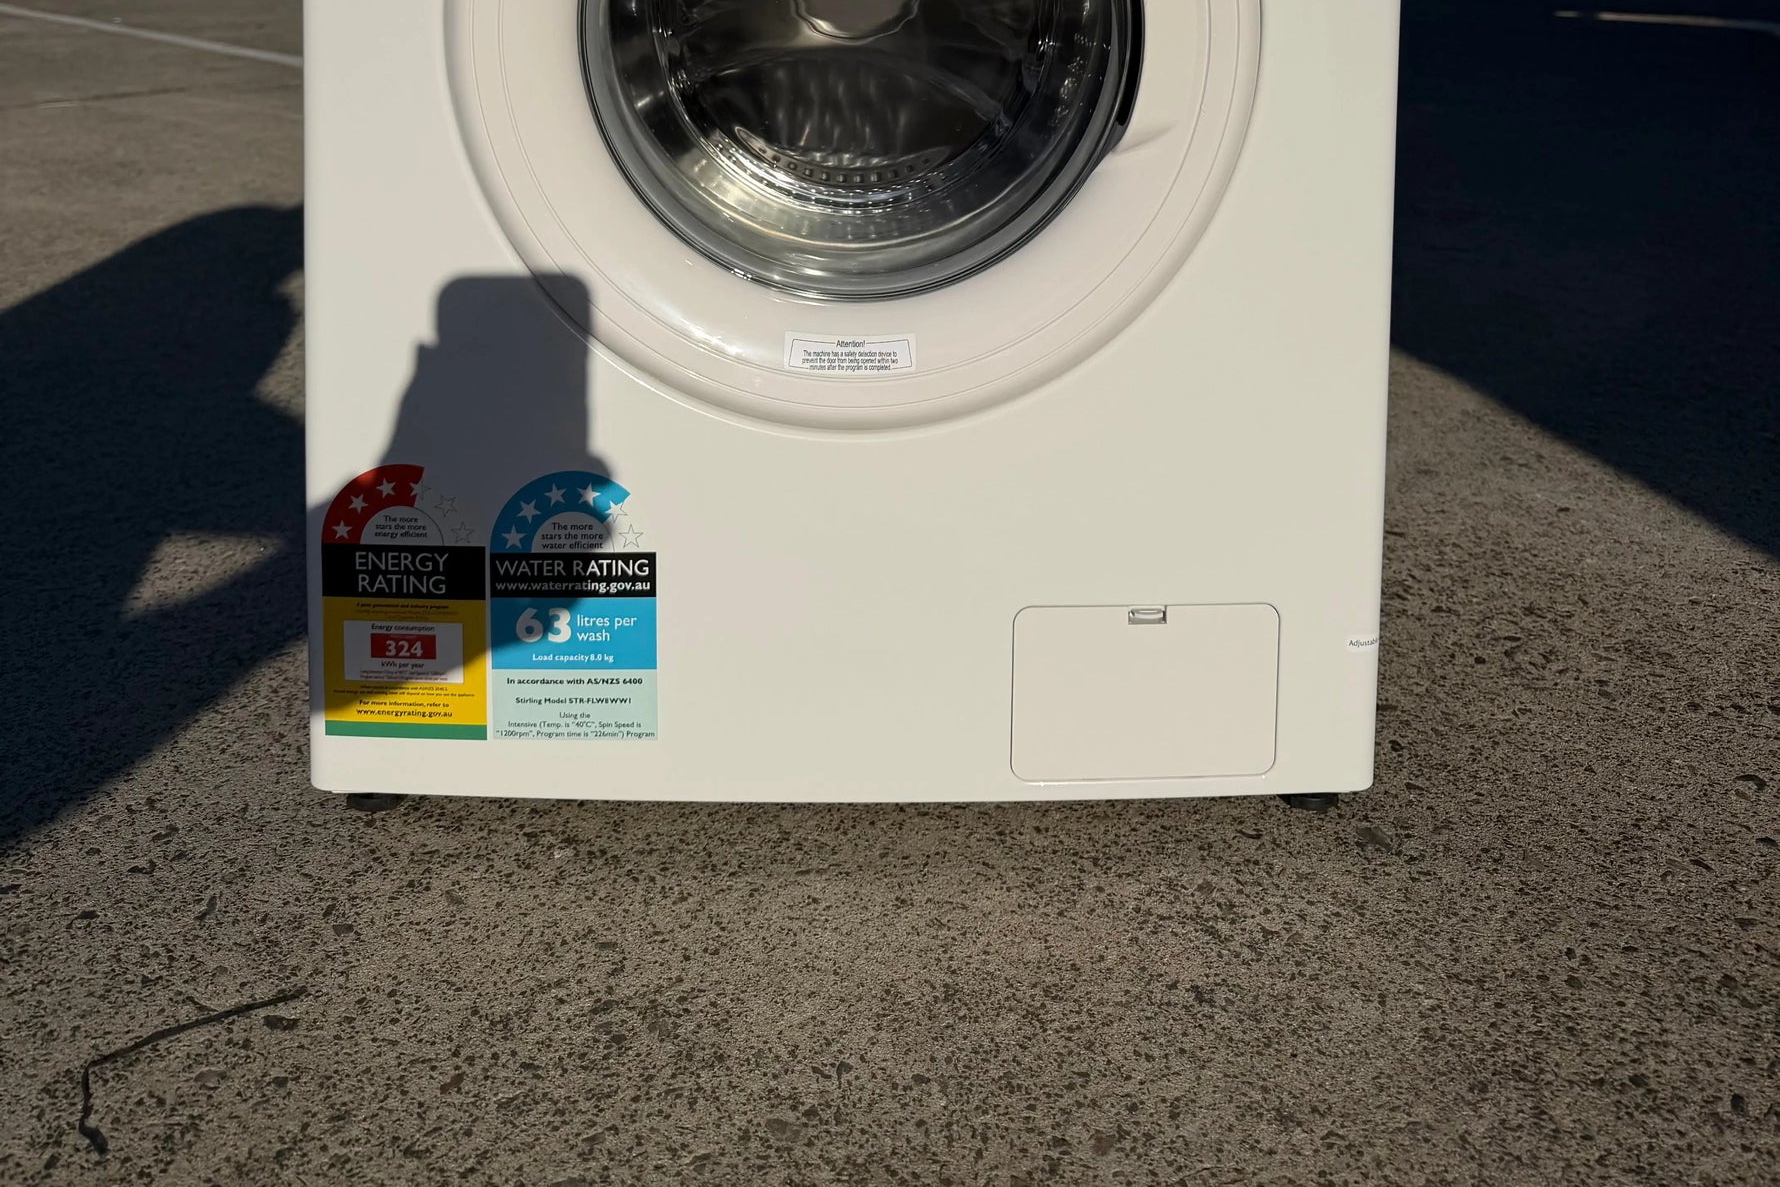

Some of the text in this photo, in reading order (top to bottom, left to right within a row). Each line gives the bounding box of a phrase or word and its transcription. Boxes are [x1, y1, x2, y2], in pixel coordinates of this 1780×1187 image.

[836, 340, 866, 348] Attention!
[803, 349, 811, 357] The
[844, 350, 857, 358] safety
[848, 357, 860, 365] being
[845, 364, 863, 372] program
[384, 514, 397, 522] The
[551, 522, 593, 531] The more
[374, 531, 399, 539] energy
[541, 532, 562, 540] stars
[564, 532, 579, 540] the
[569, 541, 604, 550] efficient
[355, 551, 449, 572] ENERGY
[495, 559, 650, 577] WATER RATING
[358, 574, 447, 595] RATING
[495, 579, 651, 593] www.waterrating.gov.au
[515, 607, 573, 644] 63
[576, 614, 638, 629] litres per
[371, 622, 436, 632] Energy consumption
[576, 629, 611, 642] wash
[385, 639, 424, 658] 324
[532, 653, 615, 663] Load capacity 8.0 kg
[411, 662, 425, 670] year
[506, 677, 516, 685] In
[388, 700, 426, 708] information,
[515, 696, 543, 706] Stirling
[356, 708, 453, 718] www.energyrating.gov.au
[559, 711, 578, 720] Using
[508, 720, 538, 728] Intensive
[539, 720, 563, 729] (Temp.
[598, 721, 613, 730] Spin
[614, 720, 635, 730] Speed
[536, 730, 565, 739] Program
[626, 730, 656, 739] Program
